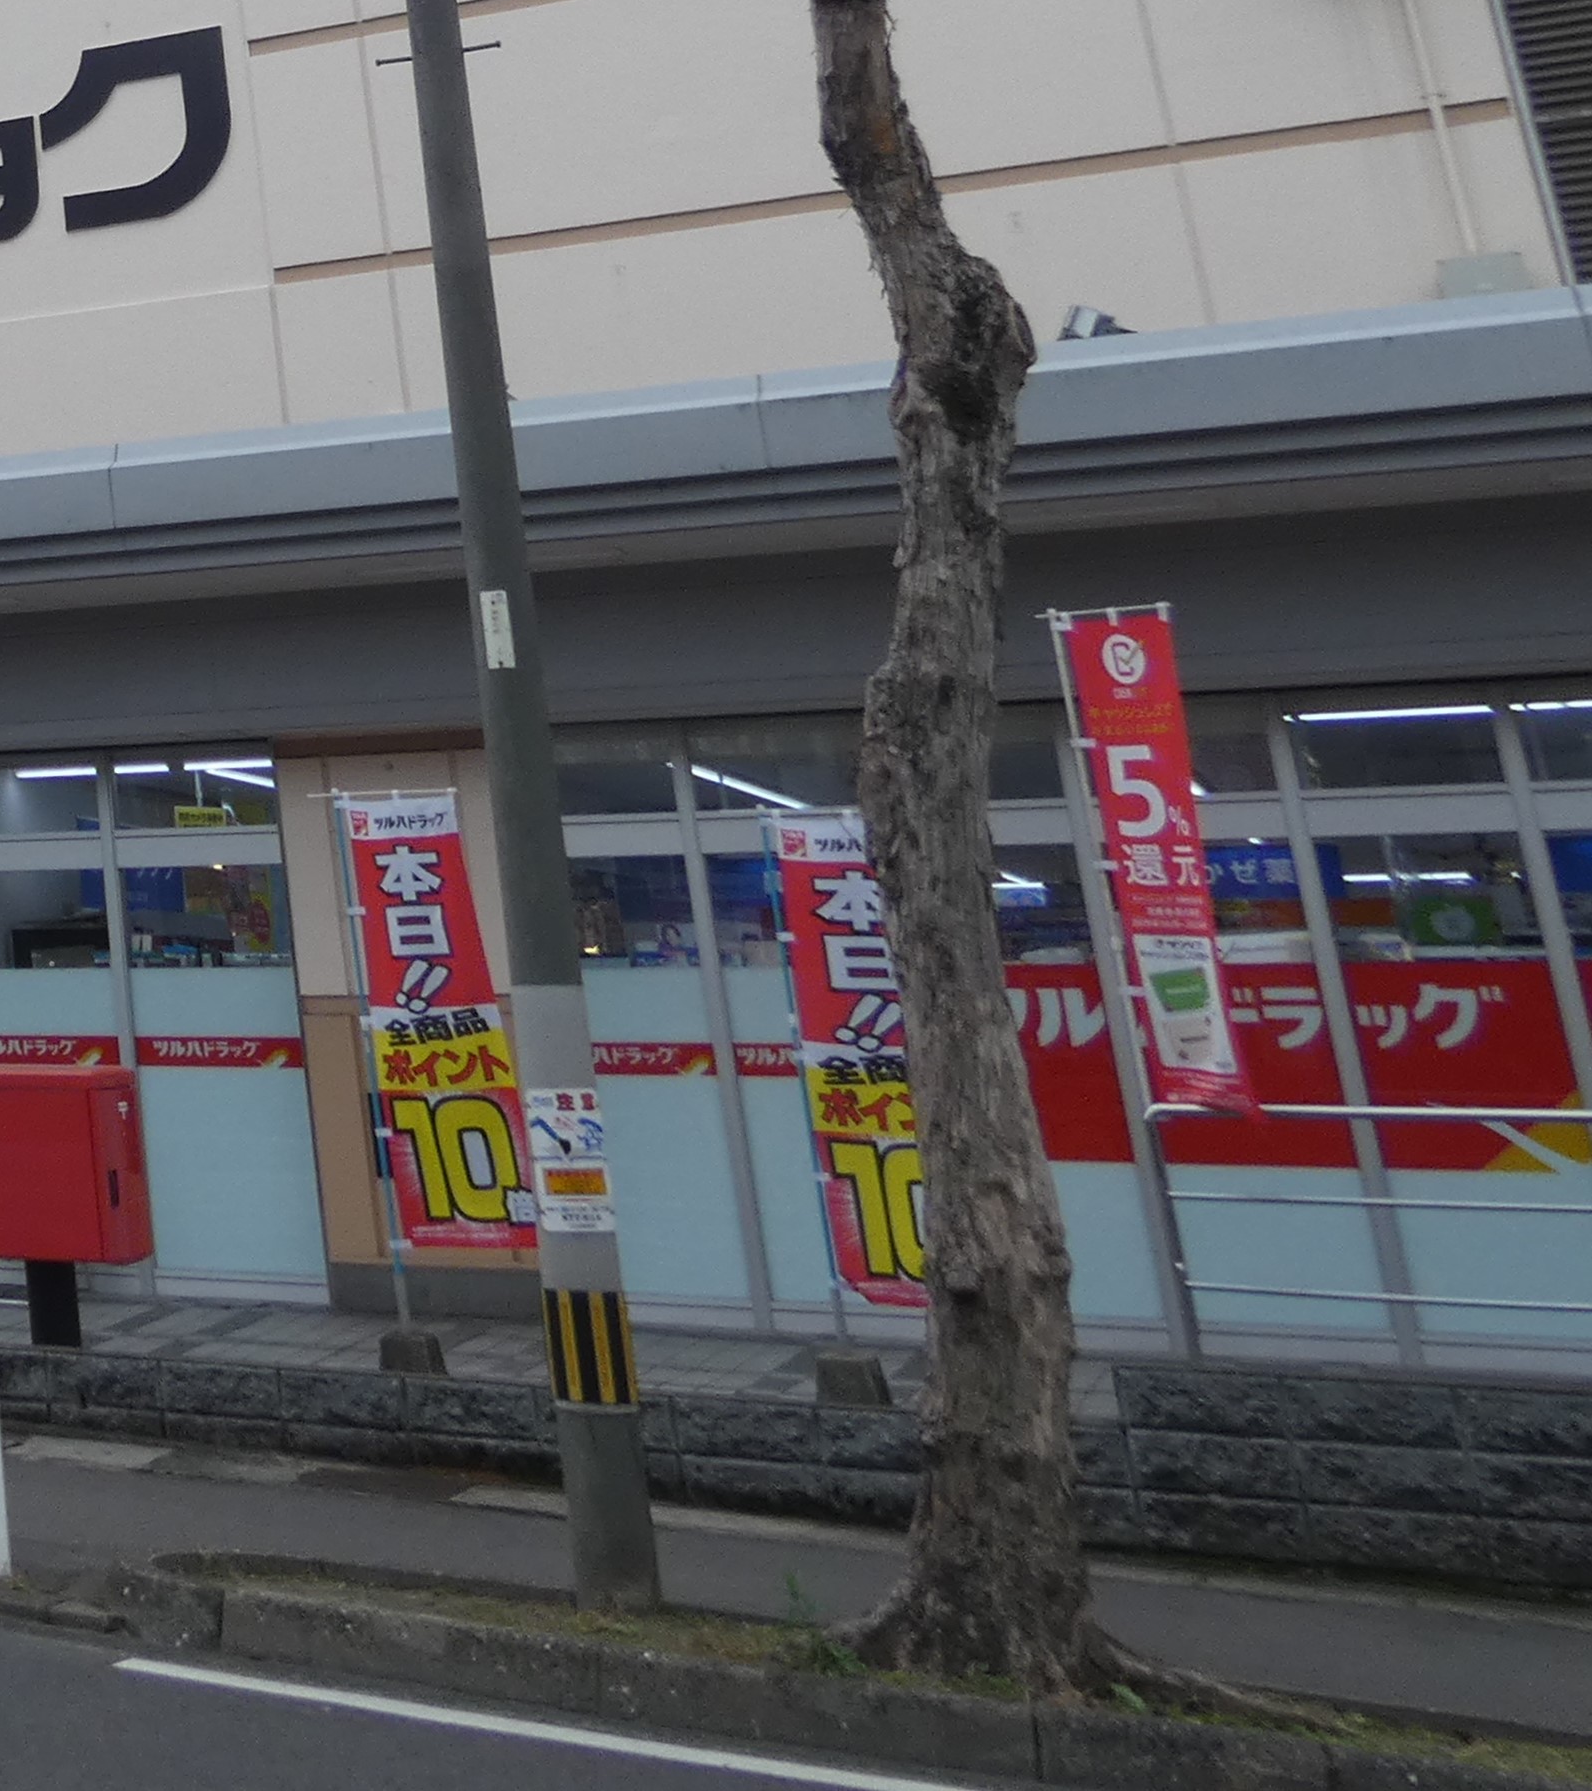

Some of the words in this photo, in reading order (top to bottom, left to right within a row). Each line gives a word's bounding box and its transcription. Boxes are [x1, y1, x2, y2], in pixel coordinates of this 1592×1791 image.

[373, 811, 448, 831] ツルハドラッグ
[1121, 843, 1201, 887] 還元
[384, 1007, 491, 1047] 全商品
[152, 1039, 261, 1058] ツルハドラッグ
[382, 1045, 511, 1087] ポイント
